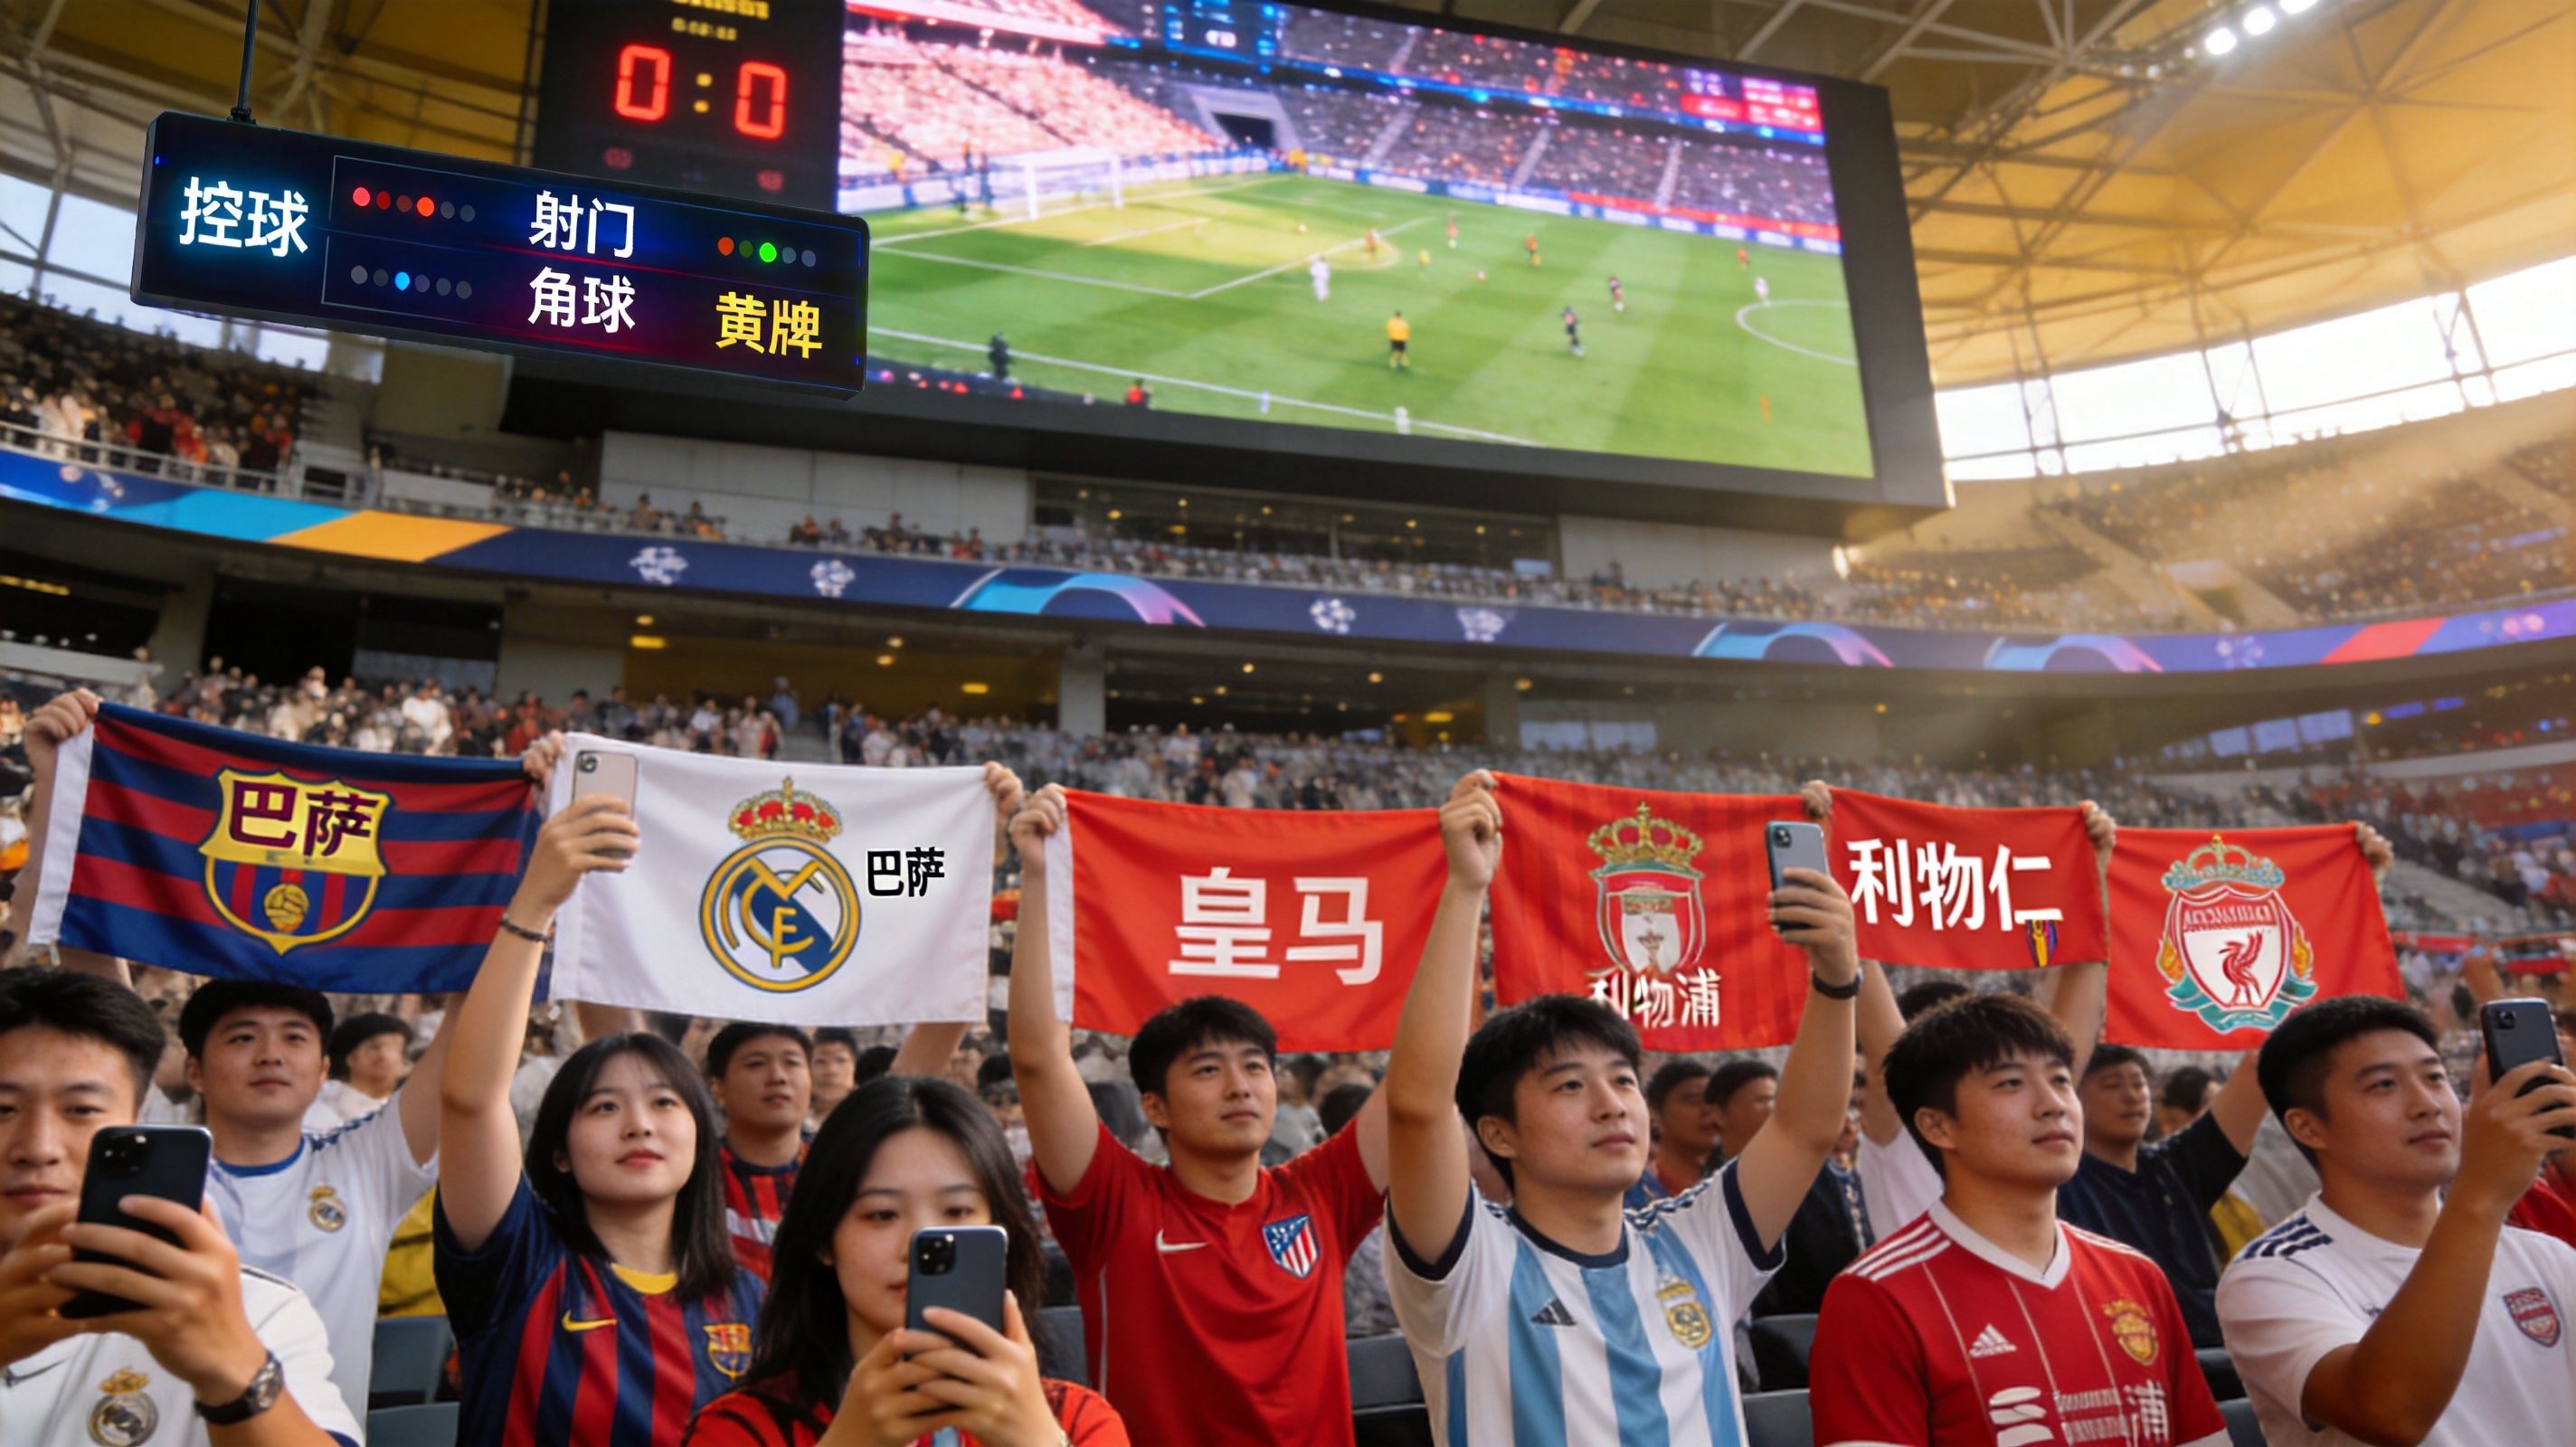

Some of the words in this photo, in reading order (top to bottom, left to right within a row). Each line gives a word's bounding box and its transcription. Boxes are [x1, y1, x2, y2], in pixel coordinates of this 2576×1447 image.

[179, 176, 308, 258] 控球
[528, 190, 635, 259] 射门
[527, 266, 636, 334] 角球
[715, 291, 823, 359] 黄牌
[229, 780, 374, 856] 巴萨
[867, 846, 945, 897] 巴萨
[1846, 837, 2063, 932] 利物仁
[1169, 866, 1383, 986] 皇马
